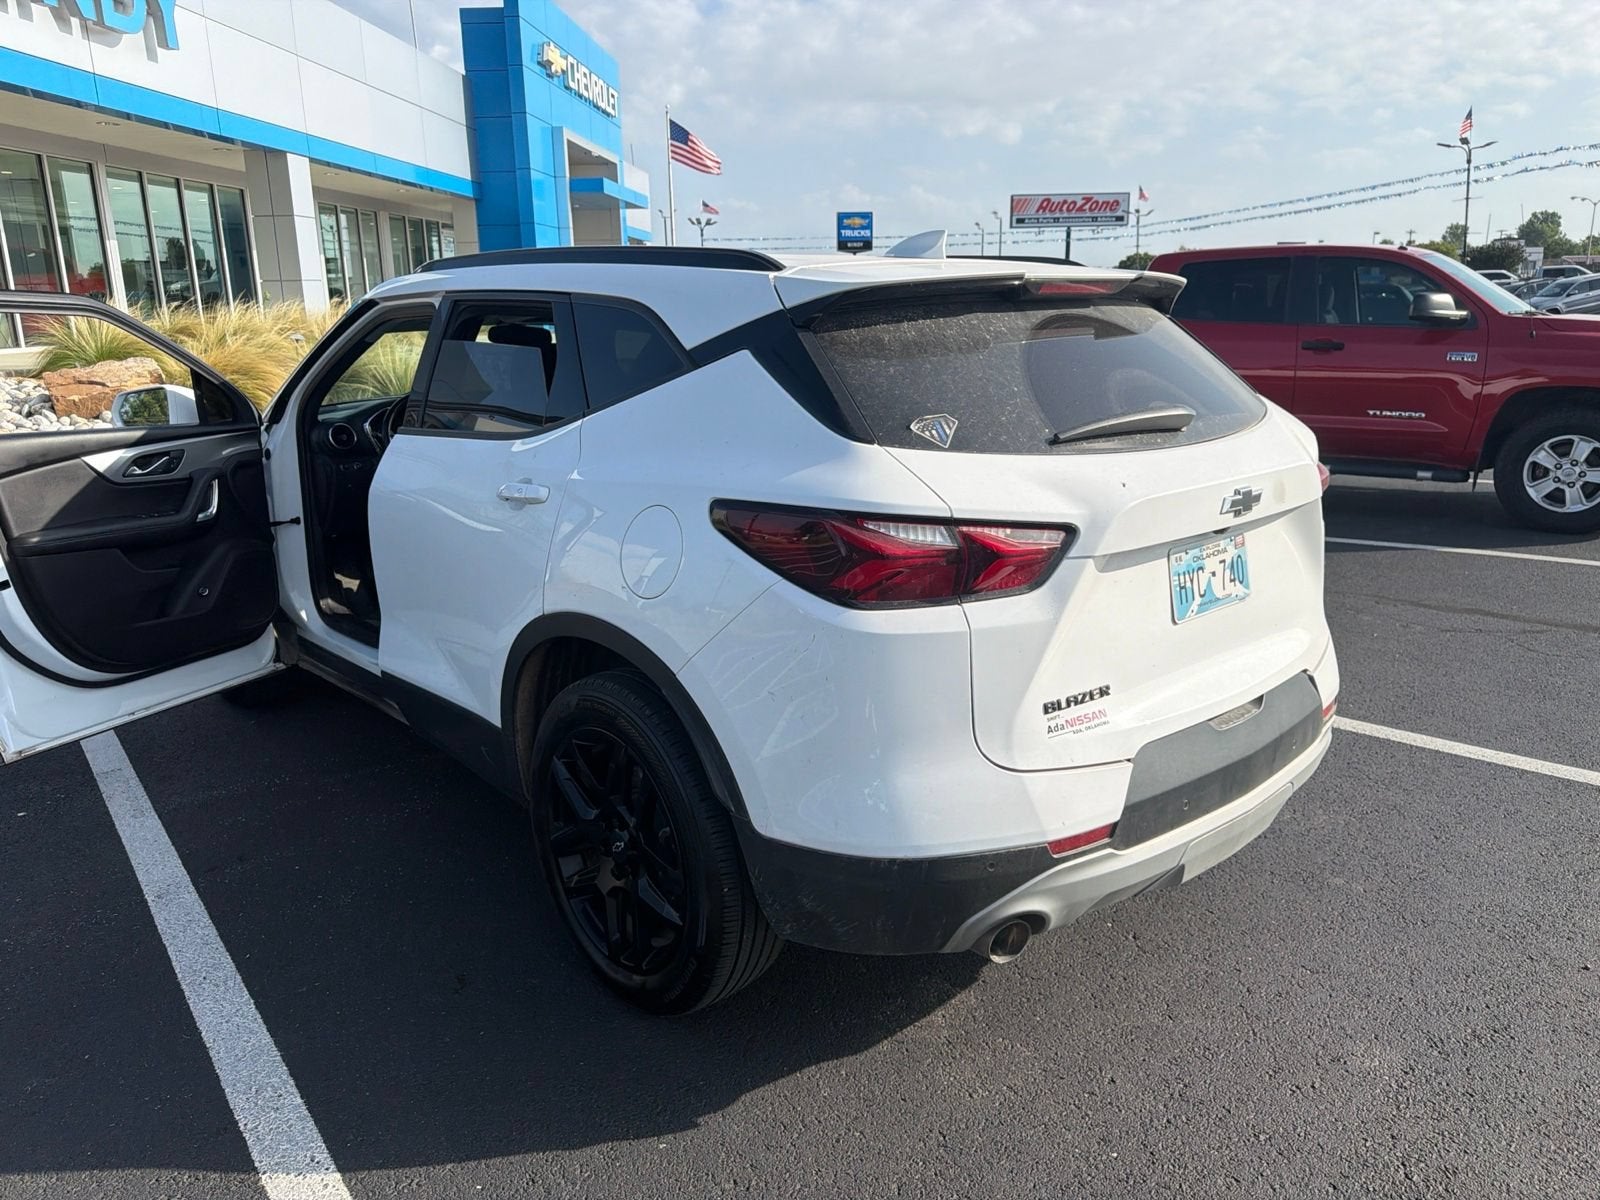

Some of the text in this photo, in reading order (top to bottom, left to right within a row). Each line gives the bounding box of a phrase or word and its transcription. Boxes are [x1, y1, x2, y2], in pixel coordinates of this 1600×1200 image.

[566, 54, 618, 118] CHEVROLET
[1036, 196, 1120, 214] AutoZone
[840, 229, 871, 237] TRUCKS
[1366, 409, 1426, 418] TUNDRA
[1192, 546, 1229, 563] OKLAHOMA
[1199, 543, 1222, 553] EXPLORE
[1042, 684, 1111, 715] BLAZER
[1084, 719, 1111, 731] OKLAHOMA
